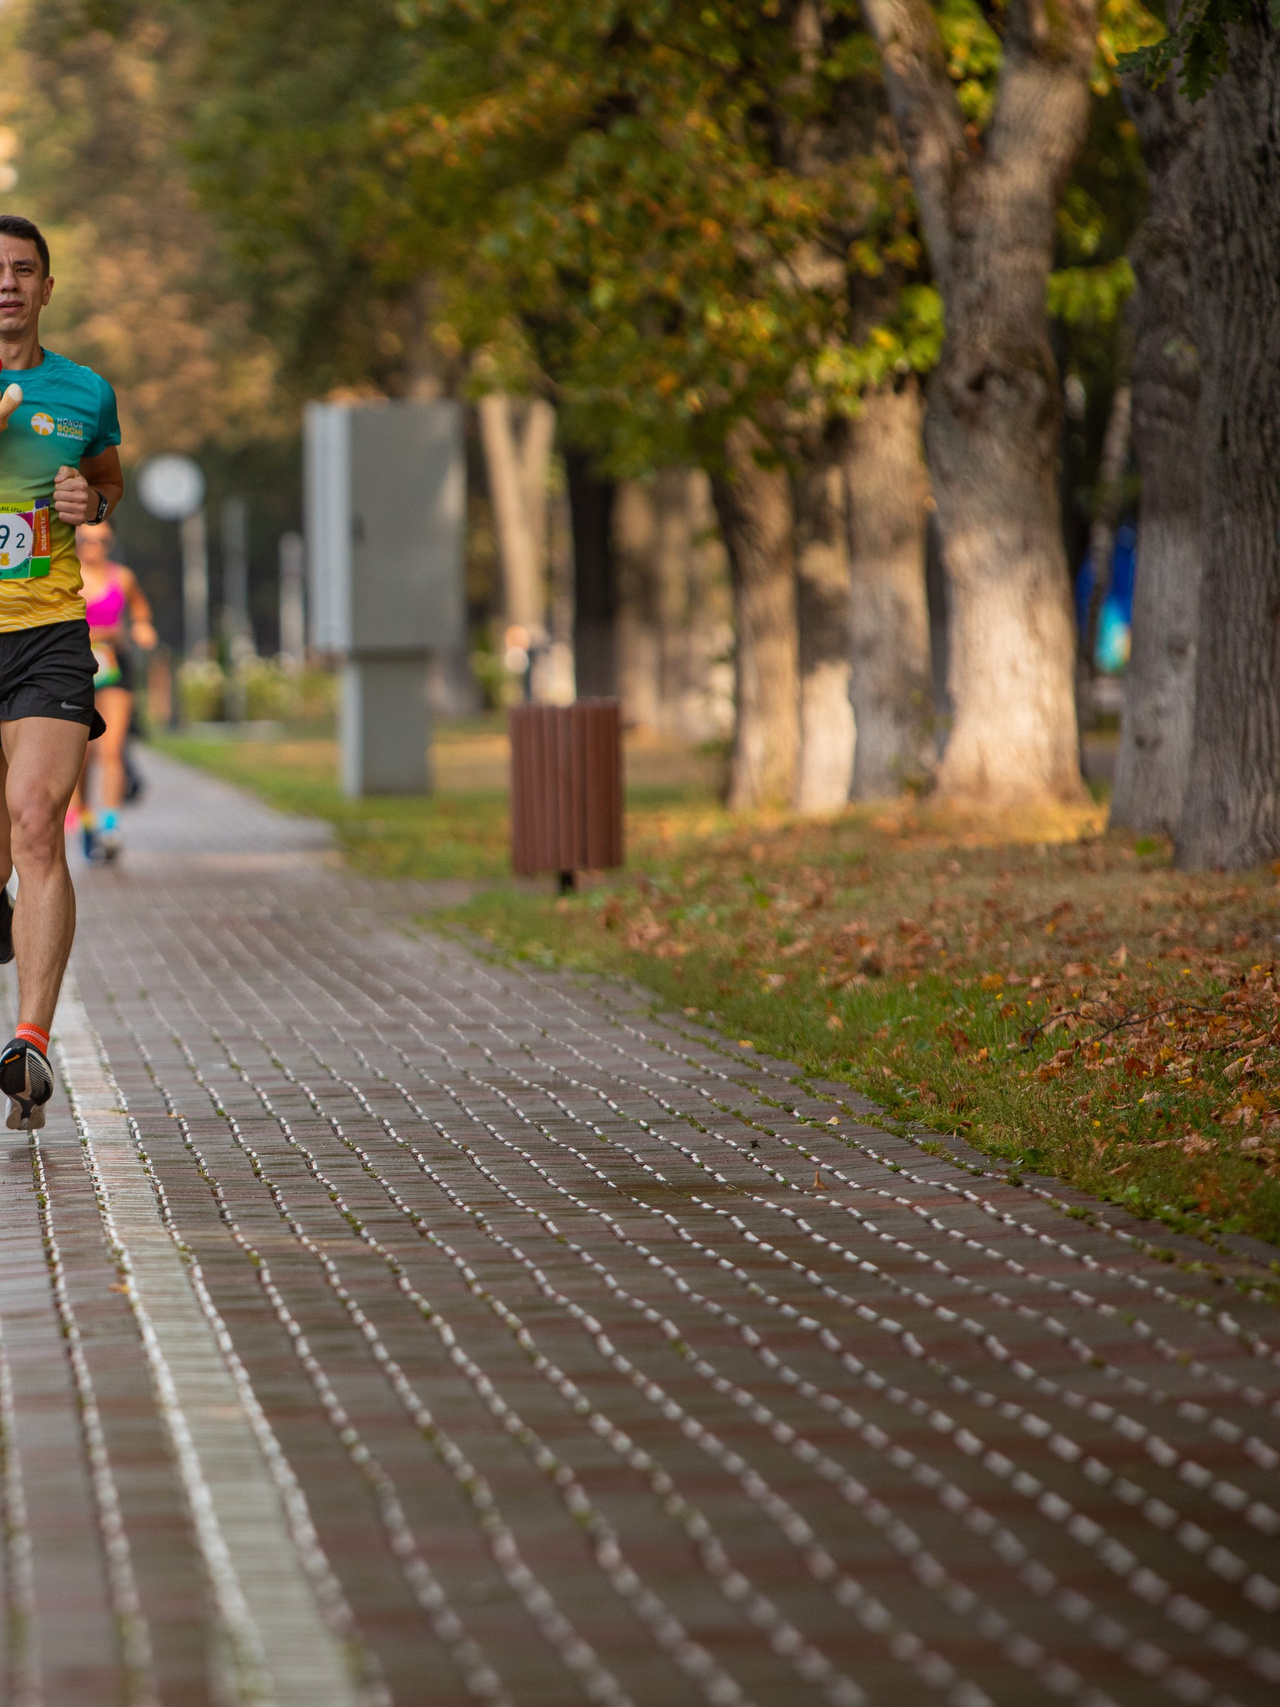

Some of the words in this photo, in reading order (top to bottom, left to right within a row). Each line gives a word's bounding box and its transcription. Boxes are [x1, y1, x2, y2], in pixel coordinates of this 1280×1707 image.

[57, 417, 83, 429] HONOR
[57, 424, 83, 437] SOCHI
[16, 532, 25, 548] 2
